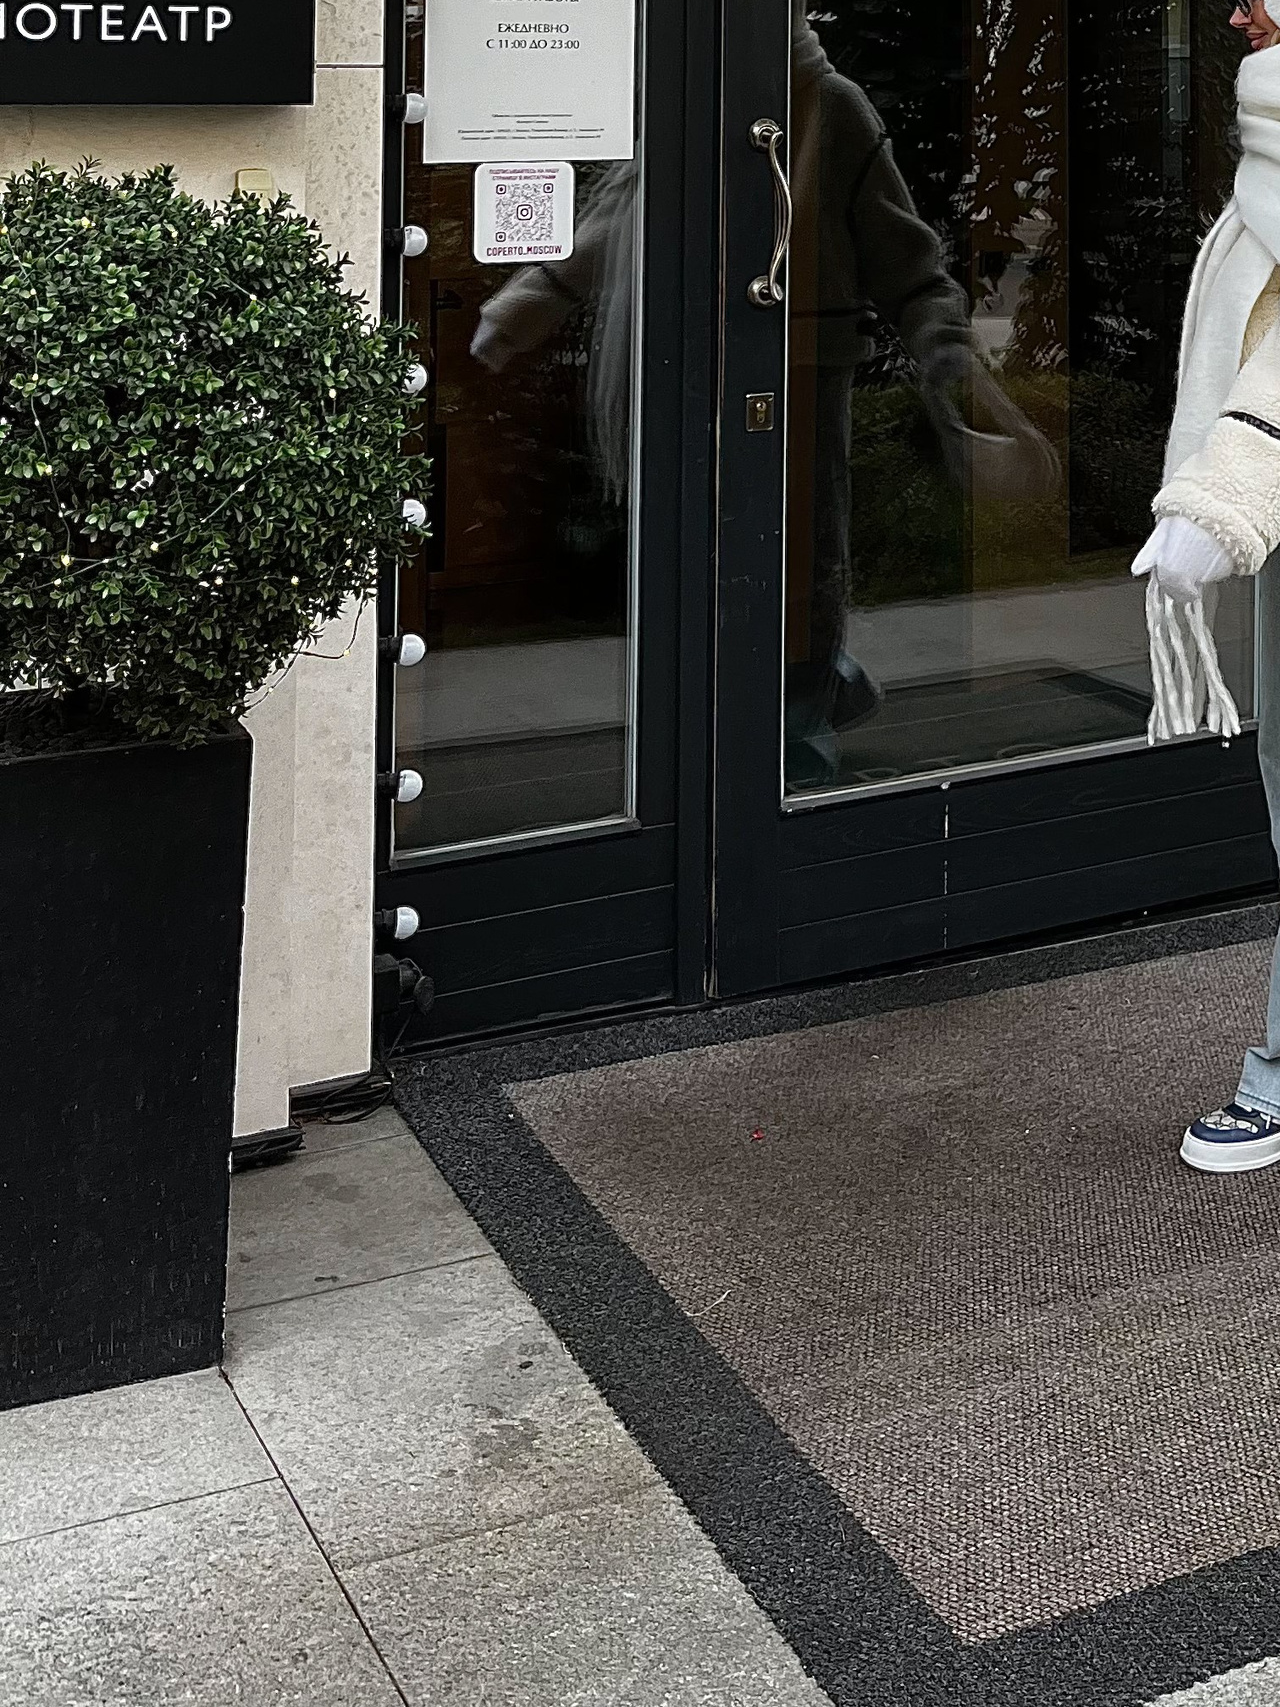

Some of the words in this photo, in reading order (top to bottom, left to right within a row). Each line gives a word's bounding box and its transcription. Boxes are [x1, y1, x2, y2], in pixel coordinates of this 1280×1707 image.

[497, 23, 570, 34] ЕЖЕДНЕВНО
[498, 39, 527, 50] 11:00
[529, 39, 548, 50] ДО
[550, 39, 580, 50] 23:00
[486, 244, 563, 257] COPERTO_MOSCOW
